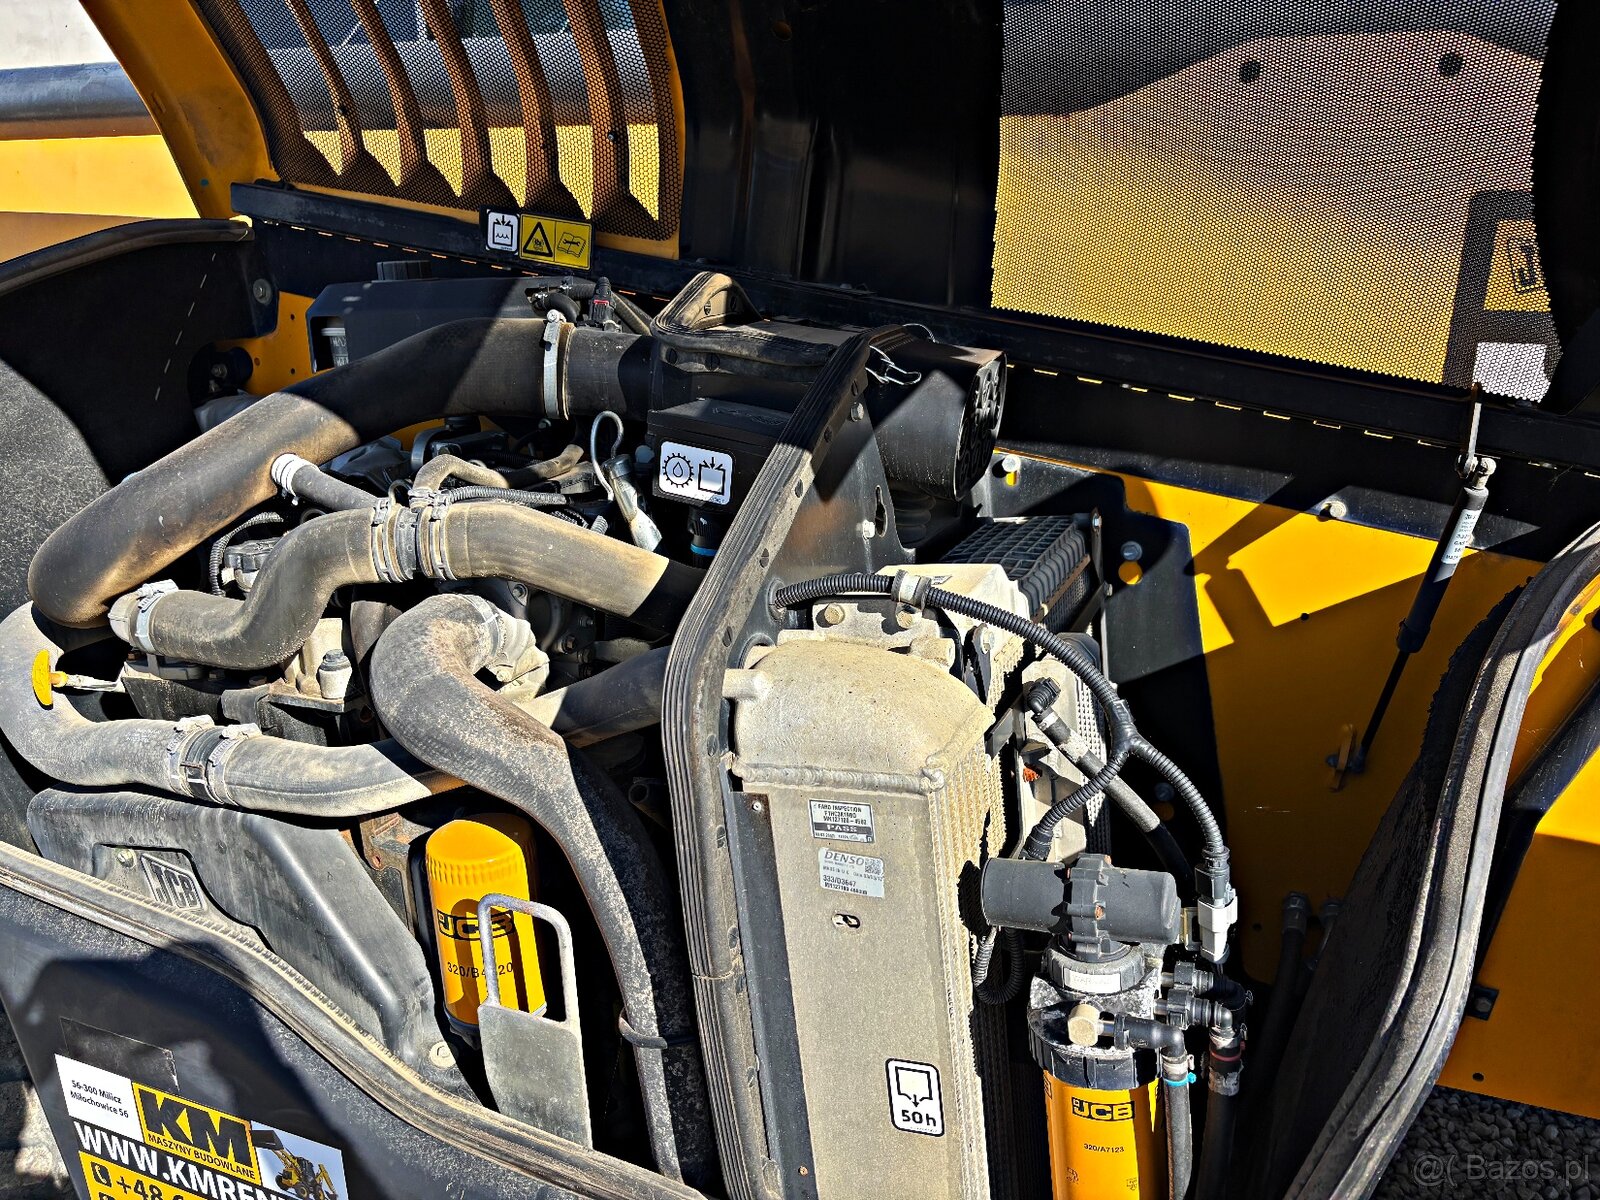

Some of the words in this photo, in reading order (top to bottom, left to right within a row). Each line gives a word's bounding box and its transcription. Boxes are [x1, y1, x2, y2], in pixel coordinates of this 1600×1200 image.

[824, 851, 864, 865] DENSO
[149, 860, 202, 909] JCB
[437, 910, 513, 940] JCB
[447, 961, 513, 978] 320/B420
[71, 1080, 98, 1096] 56-300
[98, 1089, 122, 1104] Milicz
[118, 1108, 129, 1118] 56
[1072, 1098, 1134, 1120] JCB
[138, 1088, 253, 1168] KM
[148, 1133, 191, 1157] MASZYNY
[193, 1150, 256, 1180] BUDOWLANE
[1083, 1143, 1125, 1153] 320/A7123
